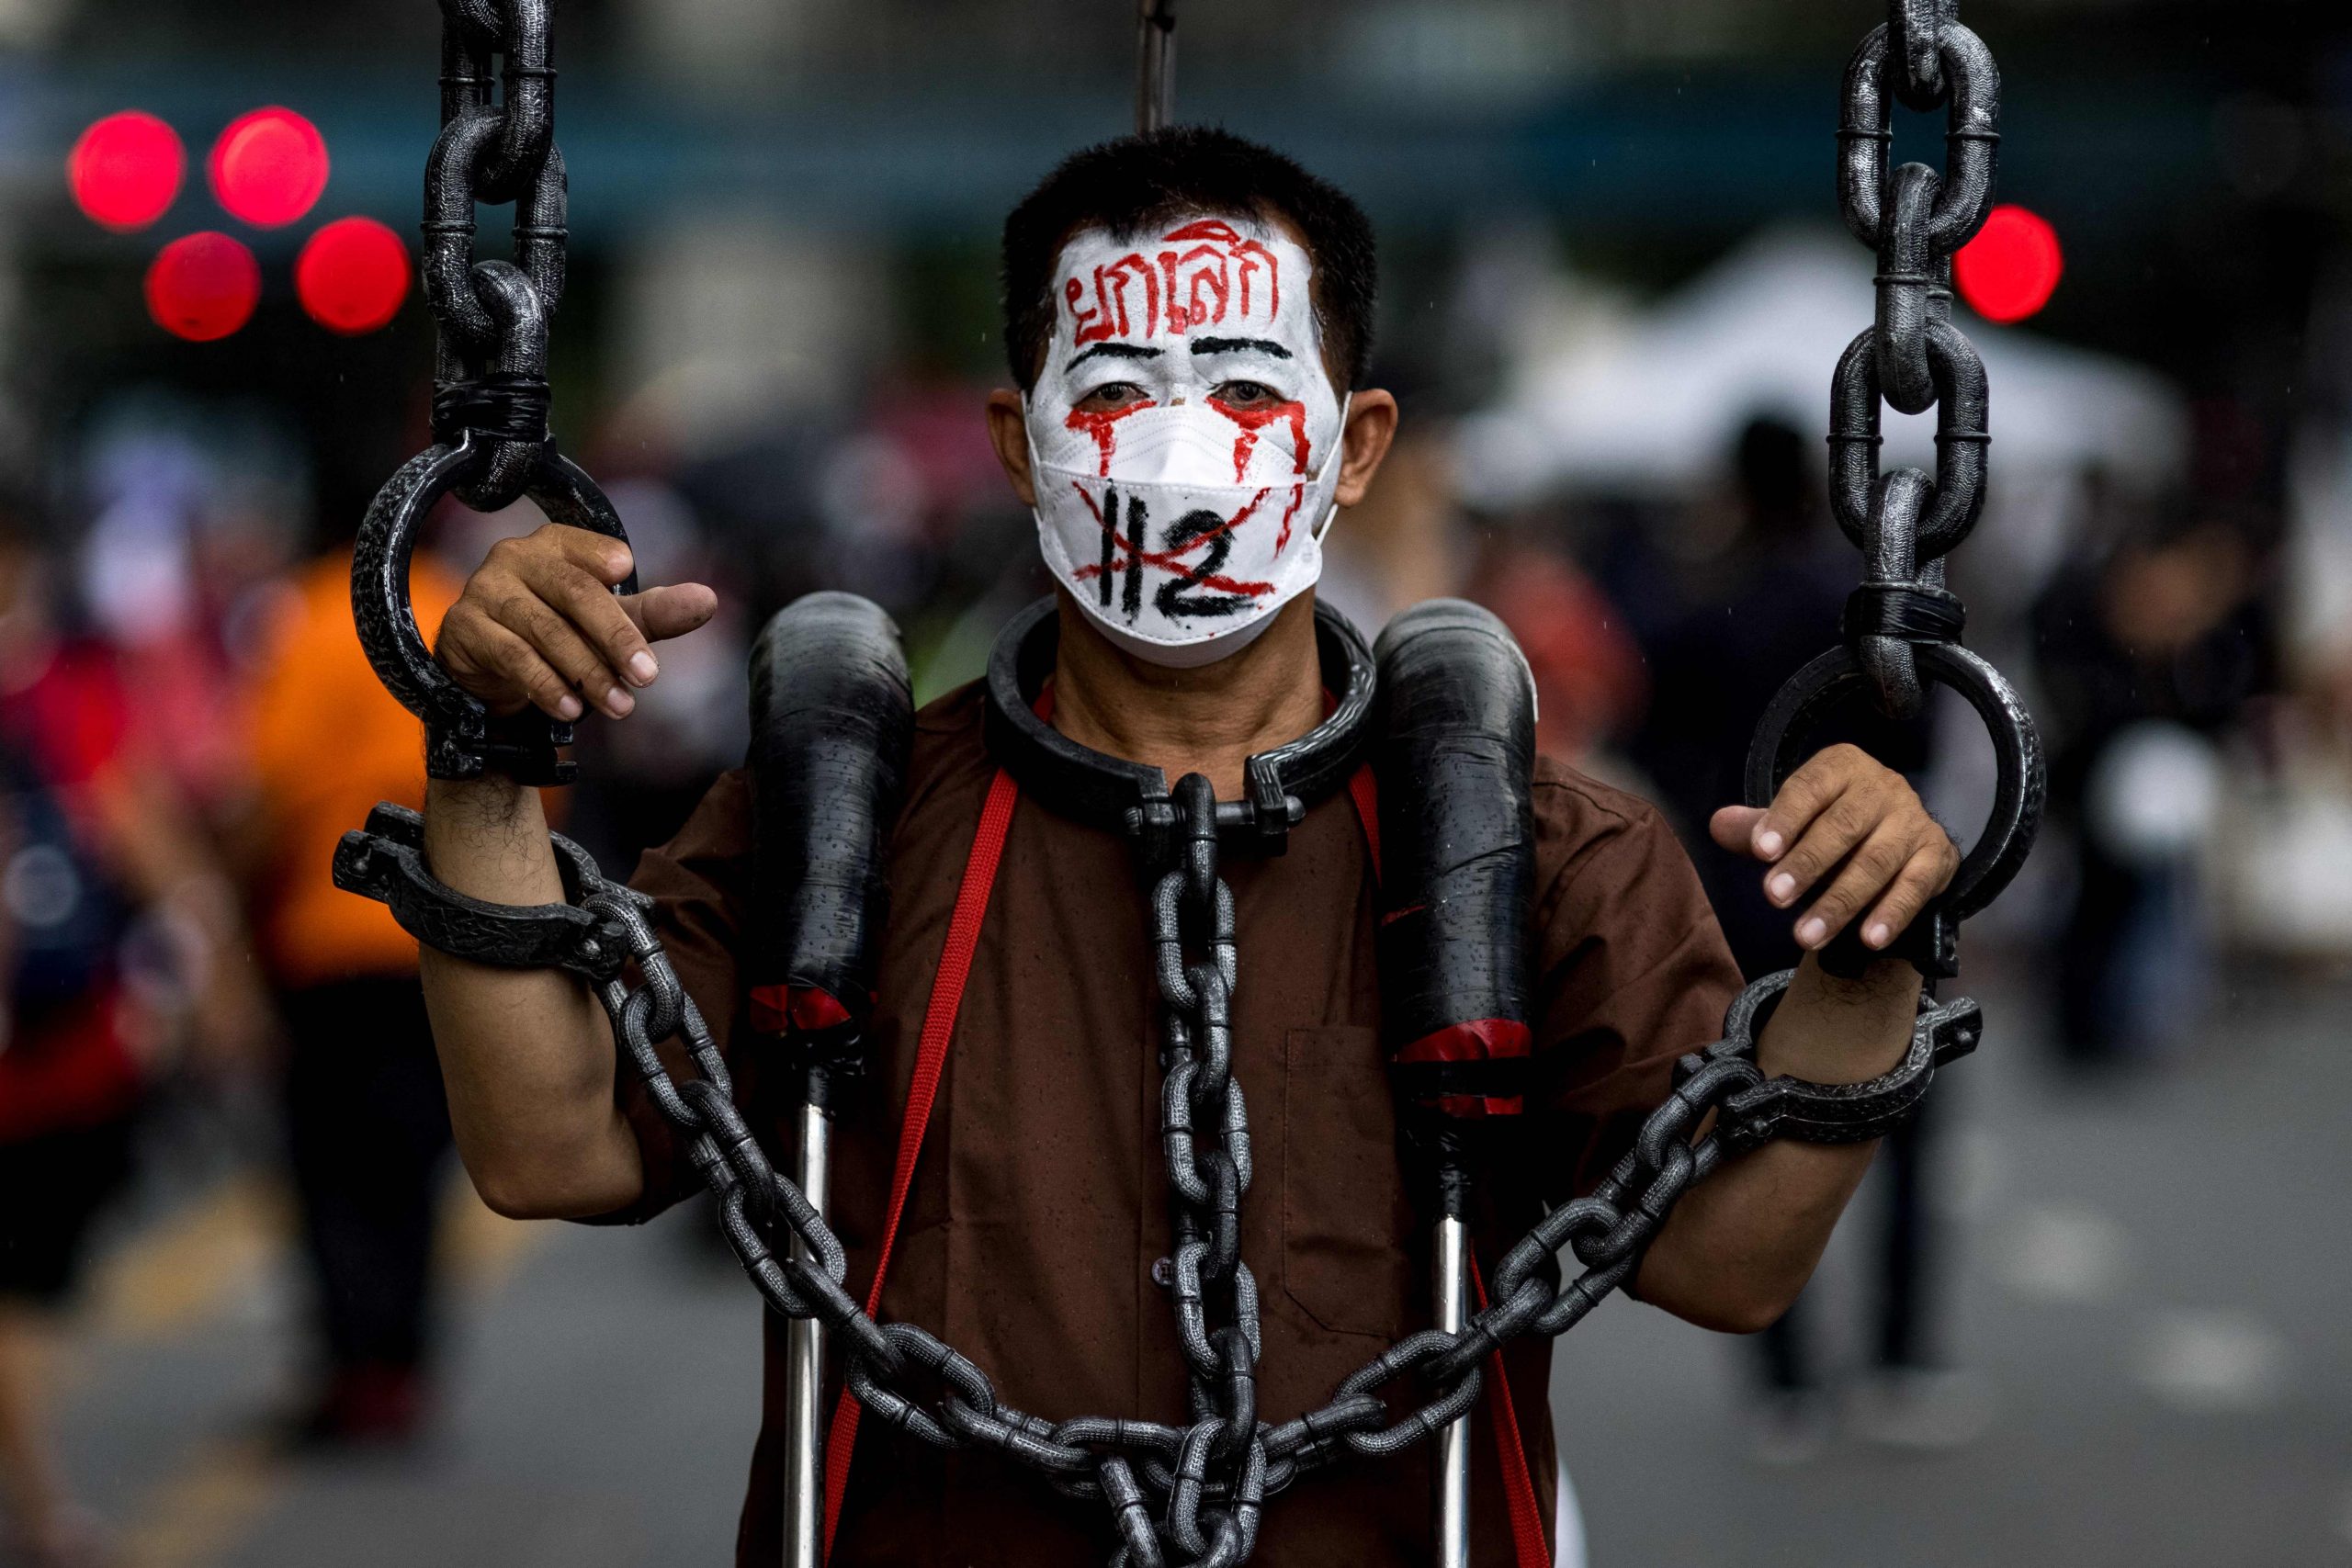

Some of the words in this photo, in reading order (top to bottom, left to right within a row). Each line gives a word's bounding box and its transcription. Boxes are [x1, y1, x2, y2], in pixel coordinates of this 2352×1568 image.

[1066, 220, 1280, 348] ยกเลิก
[1099, 479, 1257, 626] 112
